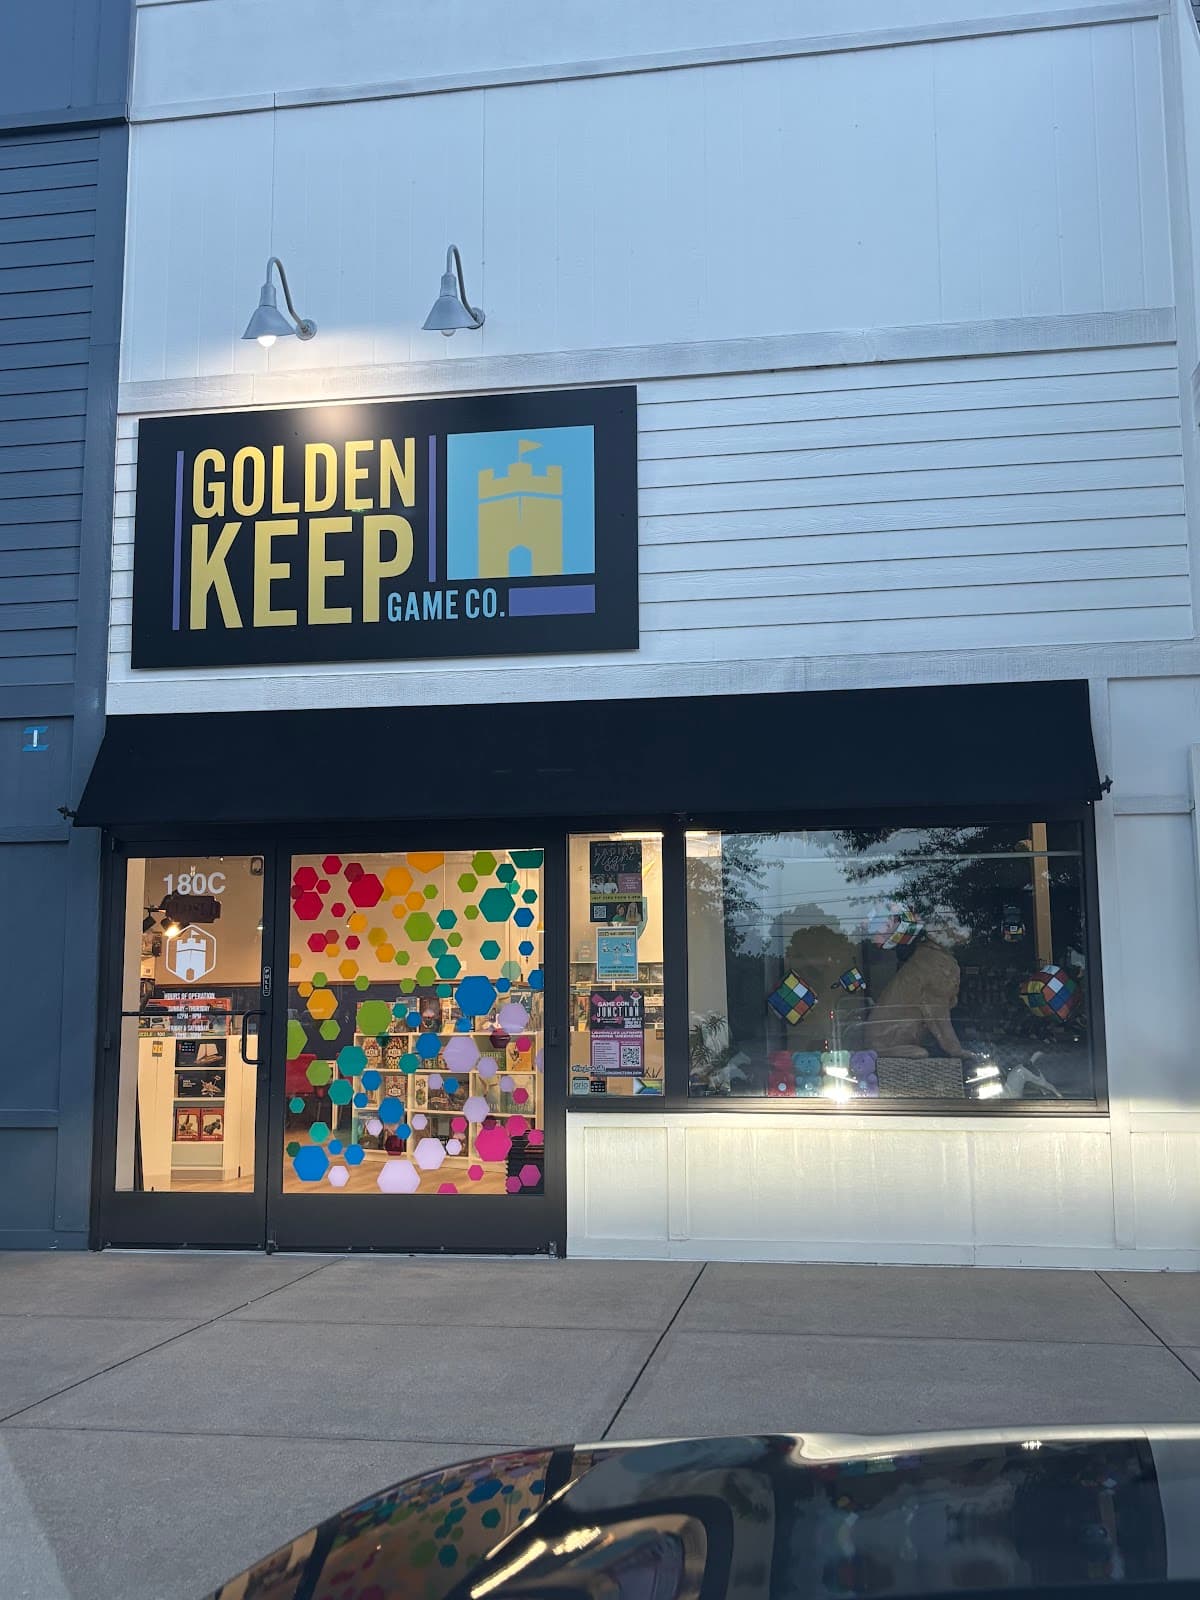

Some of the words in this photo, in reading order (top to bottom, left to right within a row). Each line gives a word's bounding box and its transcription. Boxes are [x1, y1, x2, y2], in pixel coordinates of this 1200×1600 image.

[192, 437, 416, 519] GOLDEN
[189, 515, 415, 631] KEEP
[387, 590, 458, 623] GAME
[465, 588, 505, 620] CO.
[163, 872, 226, 896] 180C
[596, 1006, 639, 1018] JUNCTION
